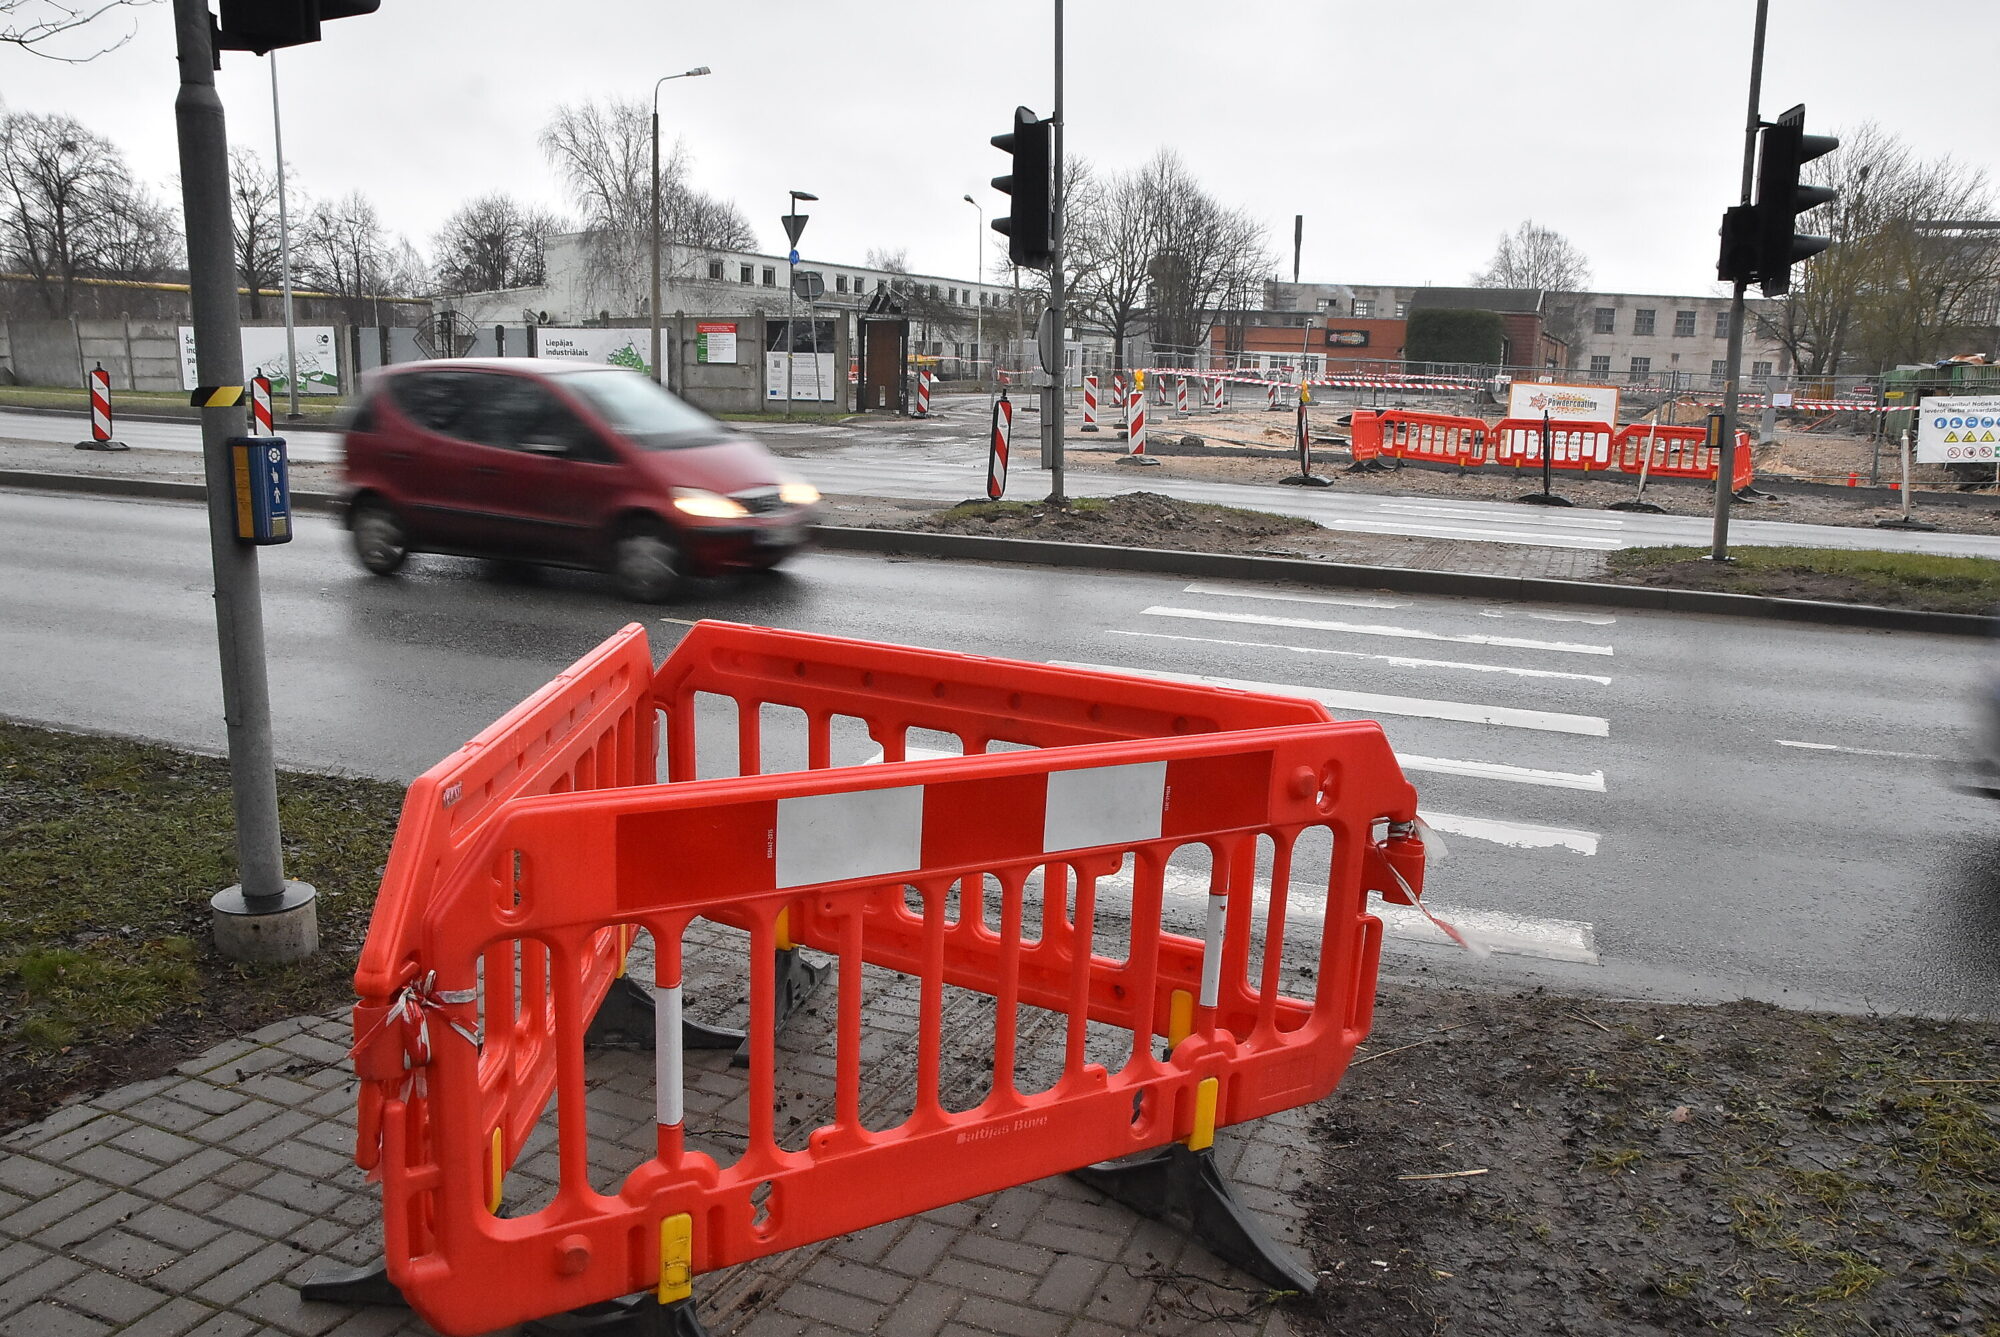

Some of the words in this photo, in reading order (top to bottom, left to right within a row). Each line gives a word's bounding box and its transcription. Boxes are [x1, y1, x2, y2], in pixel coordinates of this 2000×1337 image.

[545, 339, 574, 348] Liepājas
[545, 348, 589, 356] industriālais
[1547, 397, 1598, 411] Powdercoating
[956, 1125, 1010, 1144] Baltijas
